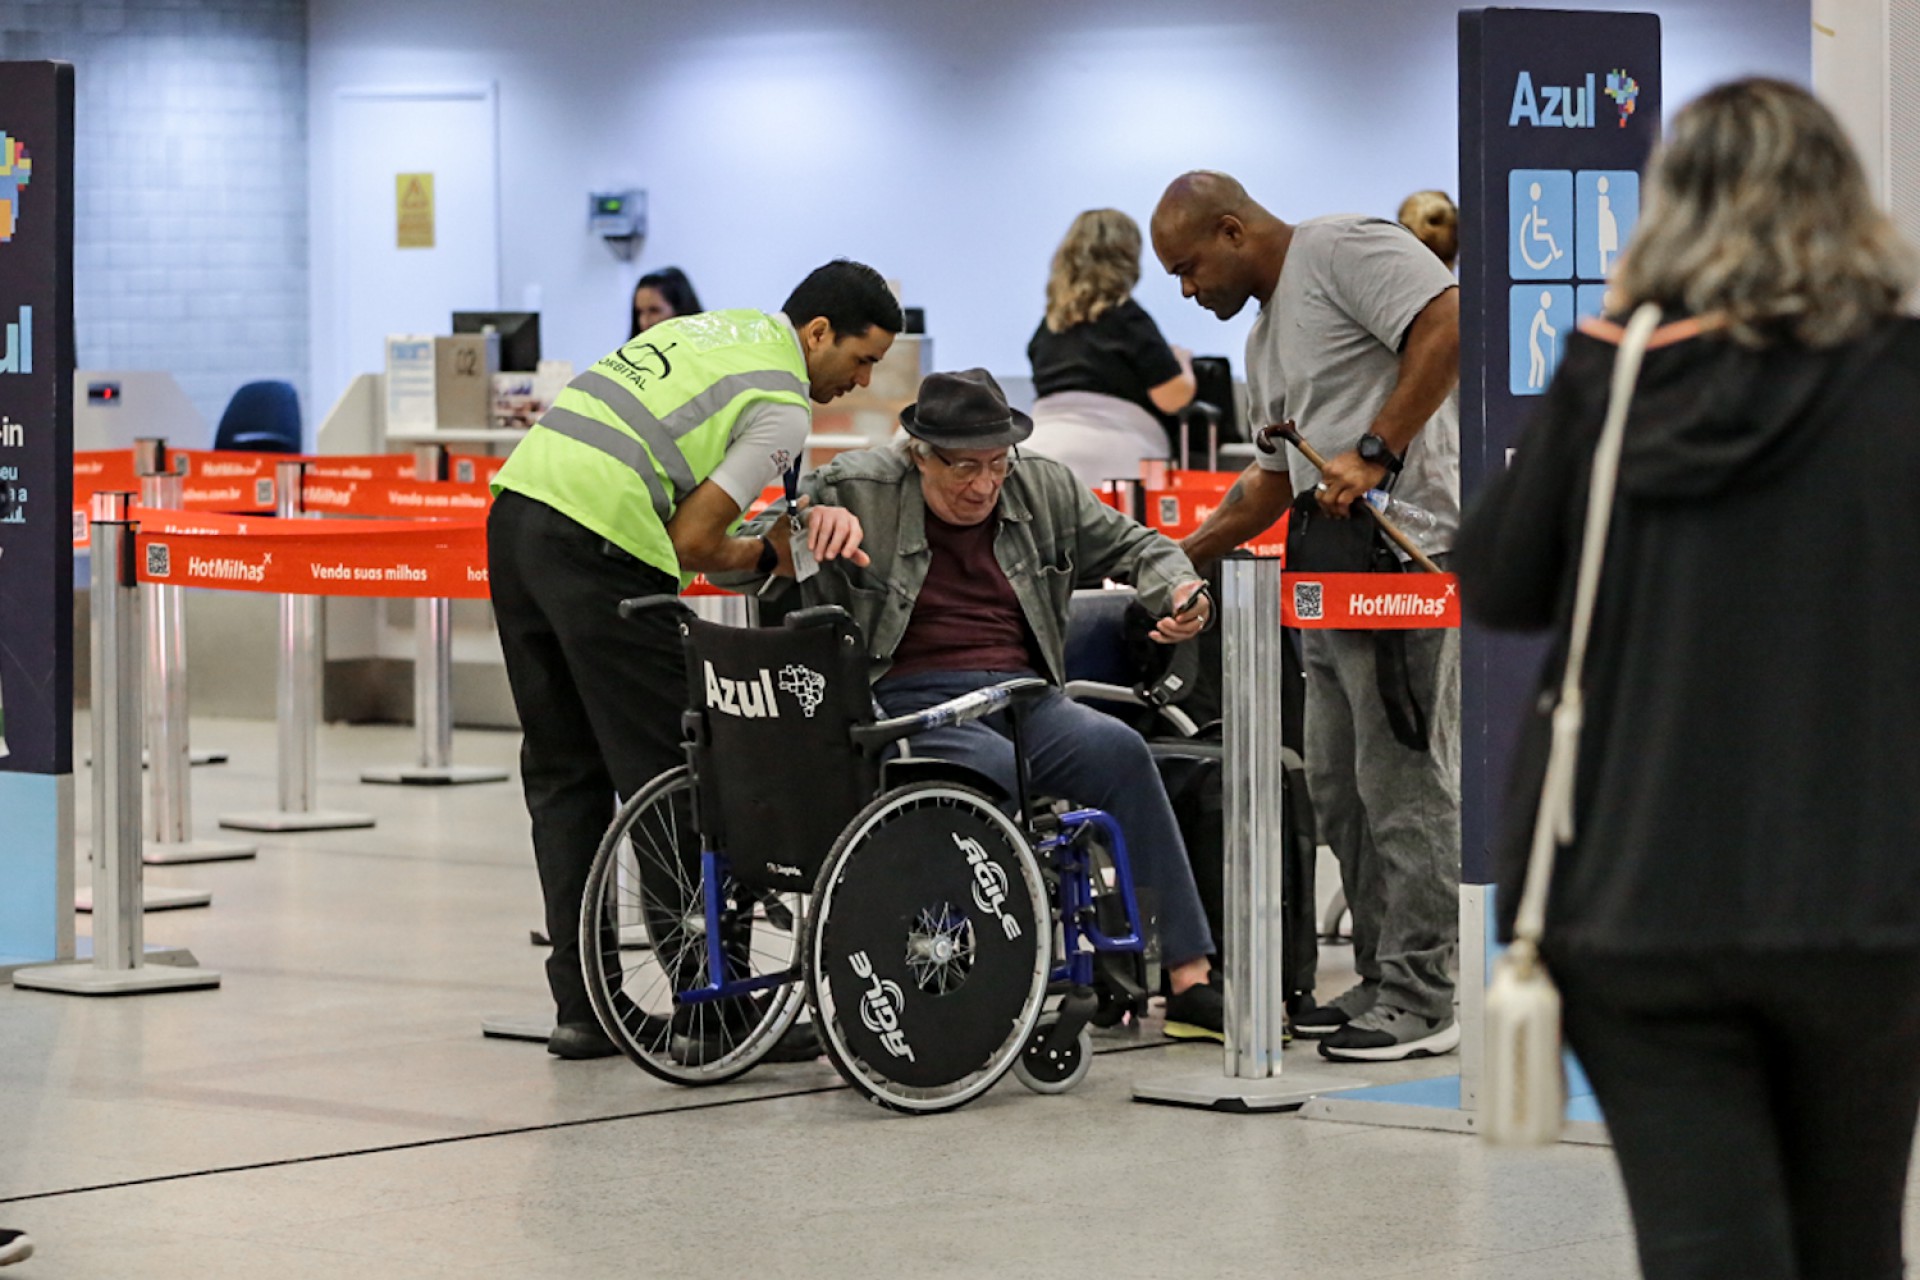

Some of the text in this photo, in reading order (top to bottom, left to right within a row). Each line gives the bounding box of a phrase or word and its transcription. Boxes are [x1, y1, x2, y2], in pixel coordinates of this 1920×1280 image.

[1508, 71, 1596, 128] Azul
[310, 563, 352, 580] Venda
[354, 567, 382, 580] suas
[385, 564, 427, 581] milhas
[704, 660, 780, 718] Azul
[951, 831, 1023, 941] AGILE
